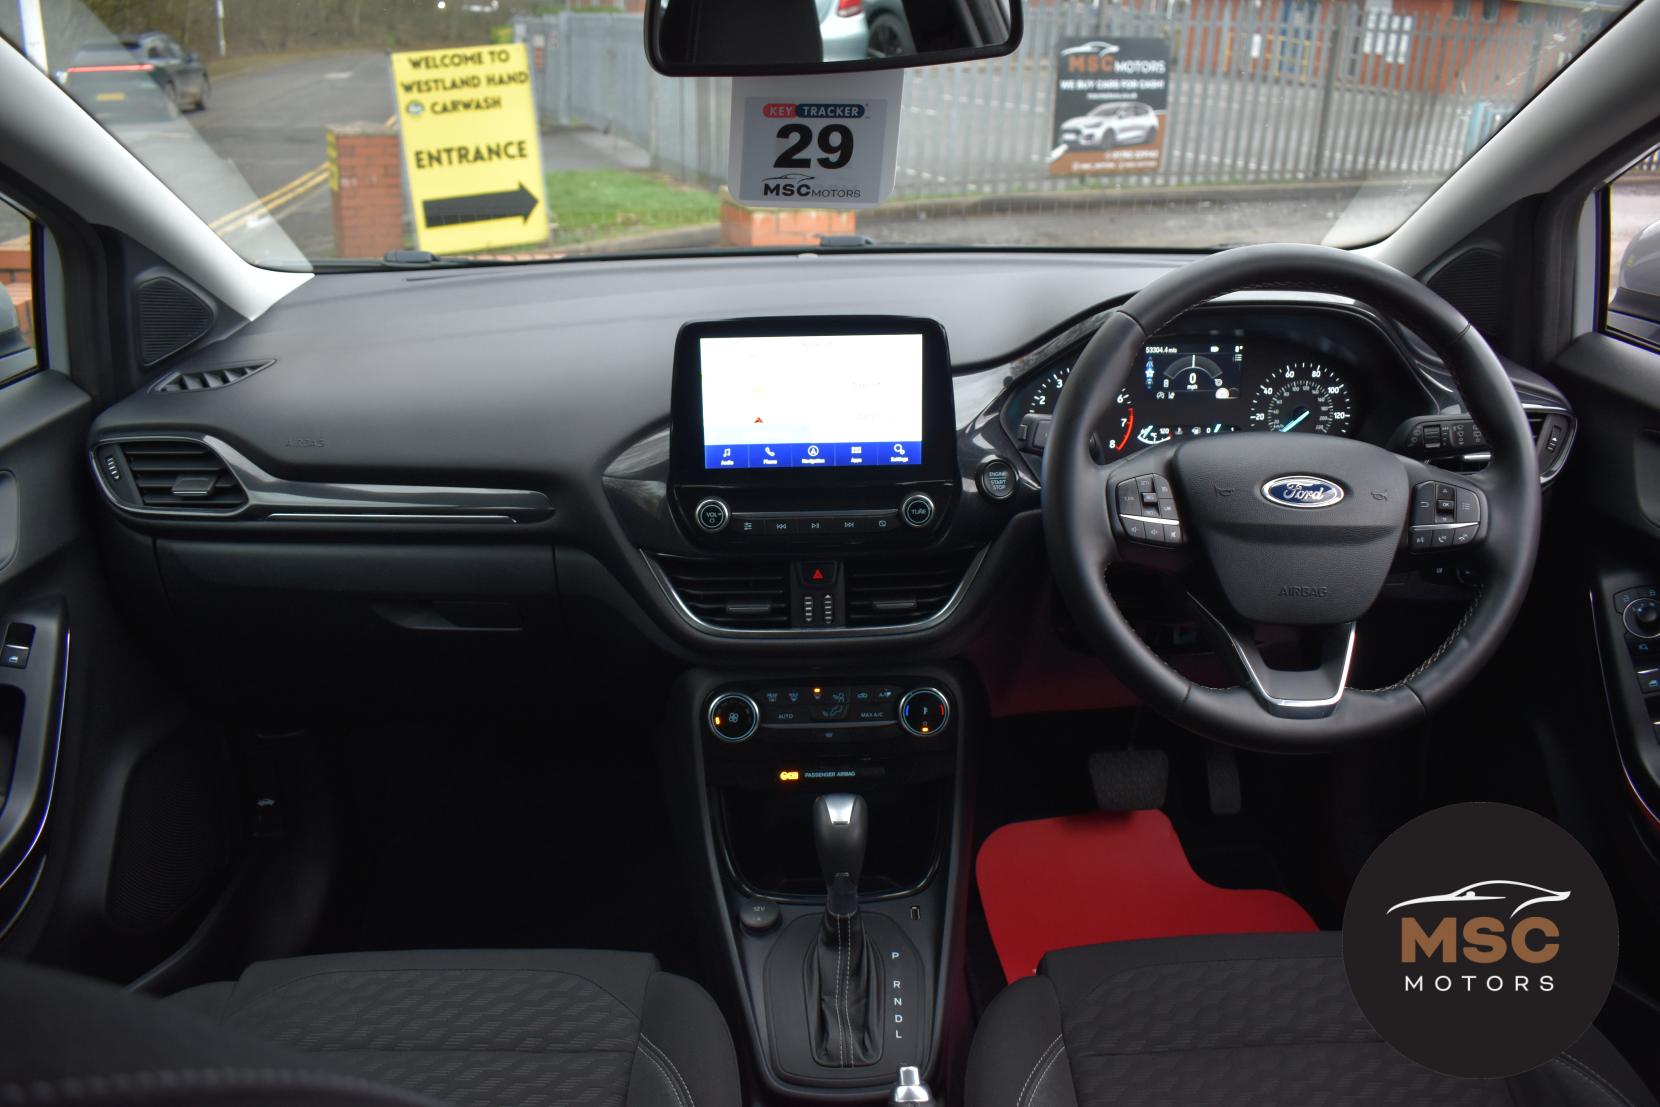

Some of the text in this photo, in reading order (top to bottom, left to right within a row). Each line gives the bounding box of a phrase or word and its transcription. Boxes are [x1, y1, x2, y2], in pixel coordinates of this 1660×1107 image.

[408, 50, 510, 69] WELCOME TO
[1114, 60, 1166, 74] MOTORS
[400, 71, 528, 94] WESTLAND HAND
[430, 96, 503, 114] CARWASH
[769, 106, 859, 116] KEY TRACKER
[773, 123, 854, 169] 29
[414, 140, 528, 169] ENTRANCE
[763, 183, 861, 198] MSC MOTORS
[1189, 372, 1197, 384] 0
[1285, 370, 1295, 378] 60
[1311, 370, 1321, 378] 80
[1056, 379, 1063, 388] 3
[1263, 387, 1273, 395] 40
[1039, 396, 1046, 405] 2
[1116, 394, 1123, 403] 6
[1255, 413, 1265, 421] 20
[1120, 418, 1127, 427] 7
[1109, 440, 1116, 448] 8
[1283, 483, 1324, 500] Ford
[1279, 585, 1327, 598] AIRBAG
[893, 980, 901, 988] R
[894, 998, 902, 1006] N
[895, 1014, 902, 1022] D
[895, 1030, 902, 1038] L
